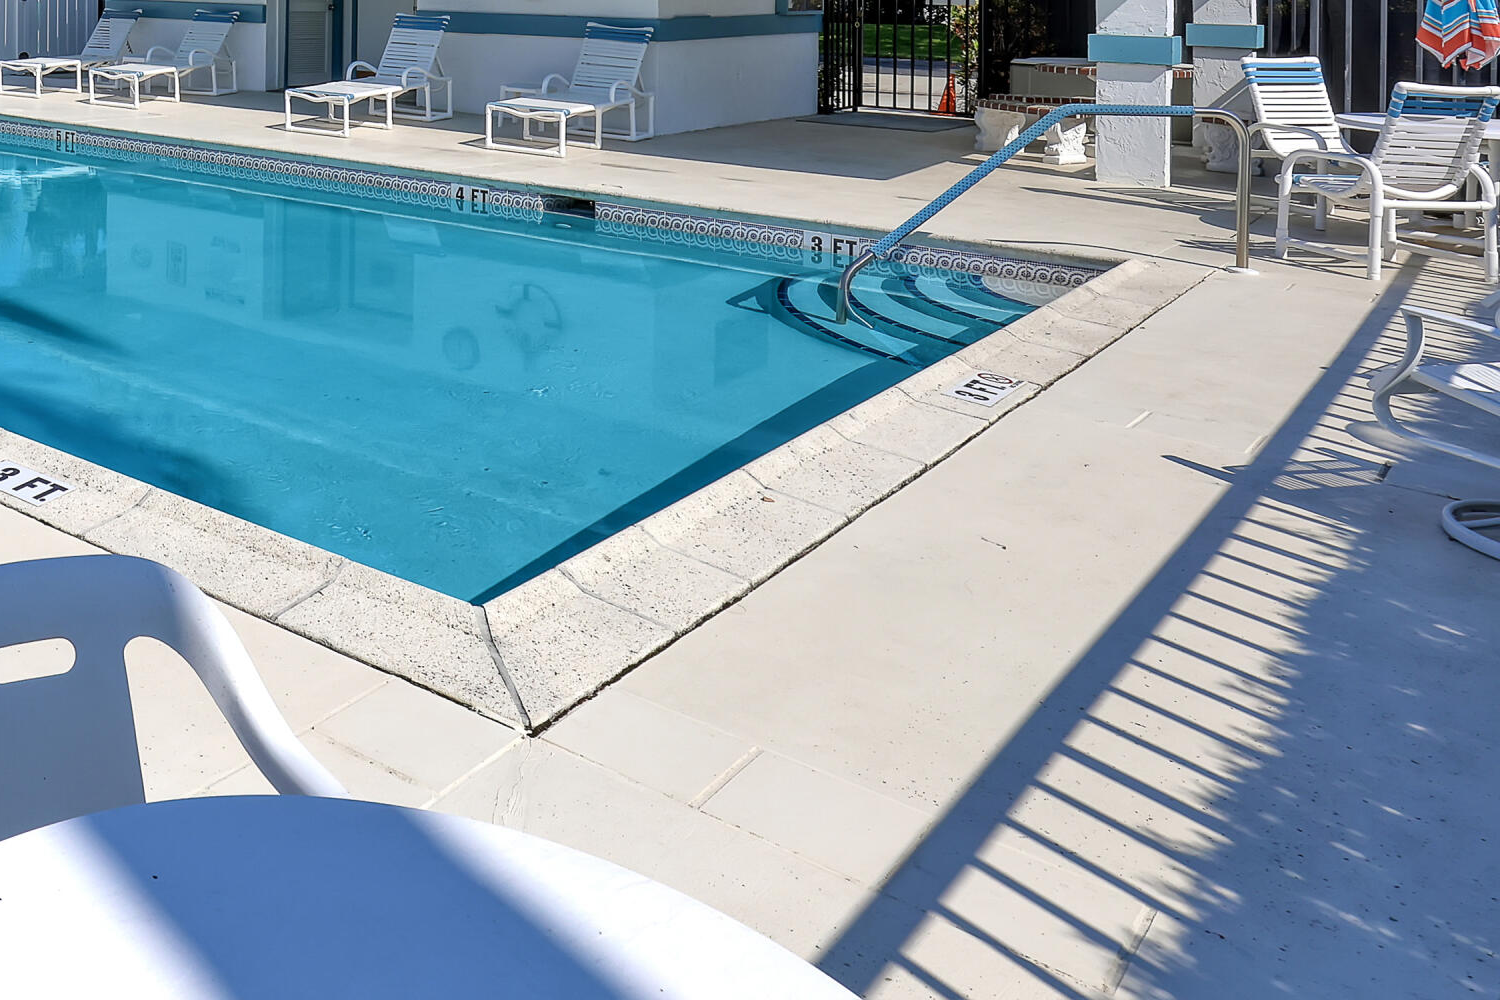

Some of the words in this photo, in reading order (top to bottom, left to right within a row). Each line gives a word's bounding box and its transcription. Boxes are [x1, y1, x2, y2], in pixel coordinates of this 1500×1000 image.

[456, 187, 464, 199] 4
[472, 189, 488, 202] FT
[811, 236, 822, 251] 3
[833, 239, 857, 256] FT
[954, 390, 990, 401] 3
[12, 477, 69, 502] FT.
